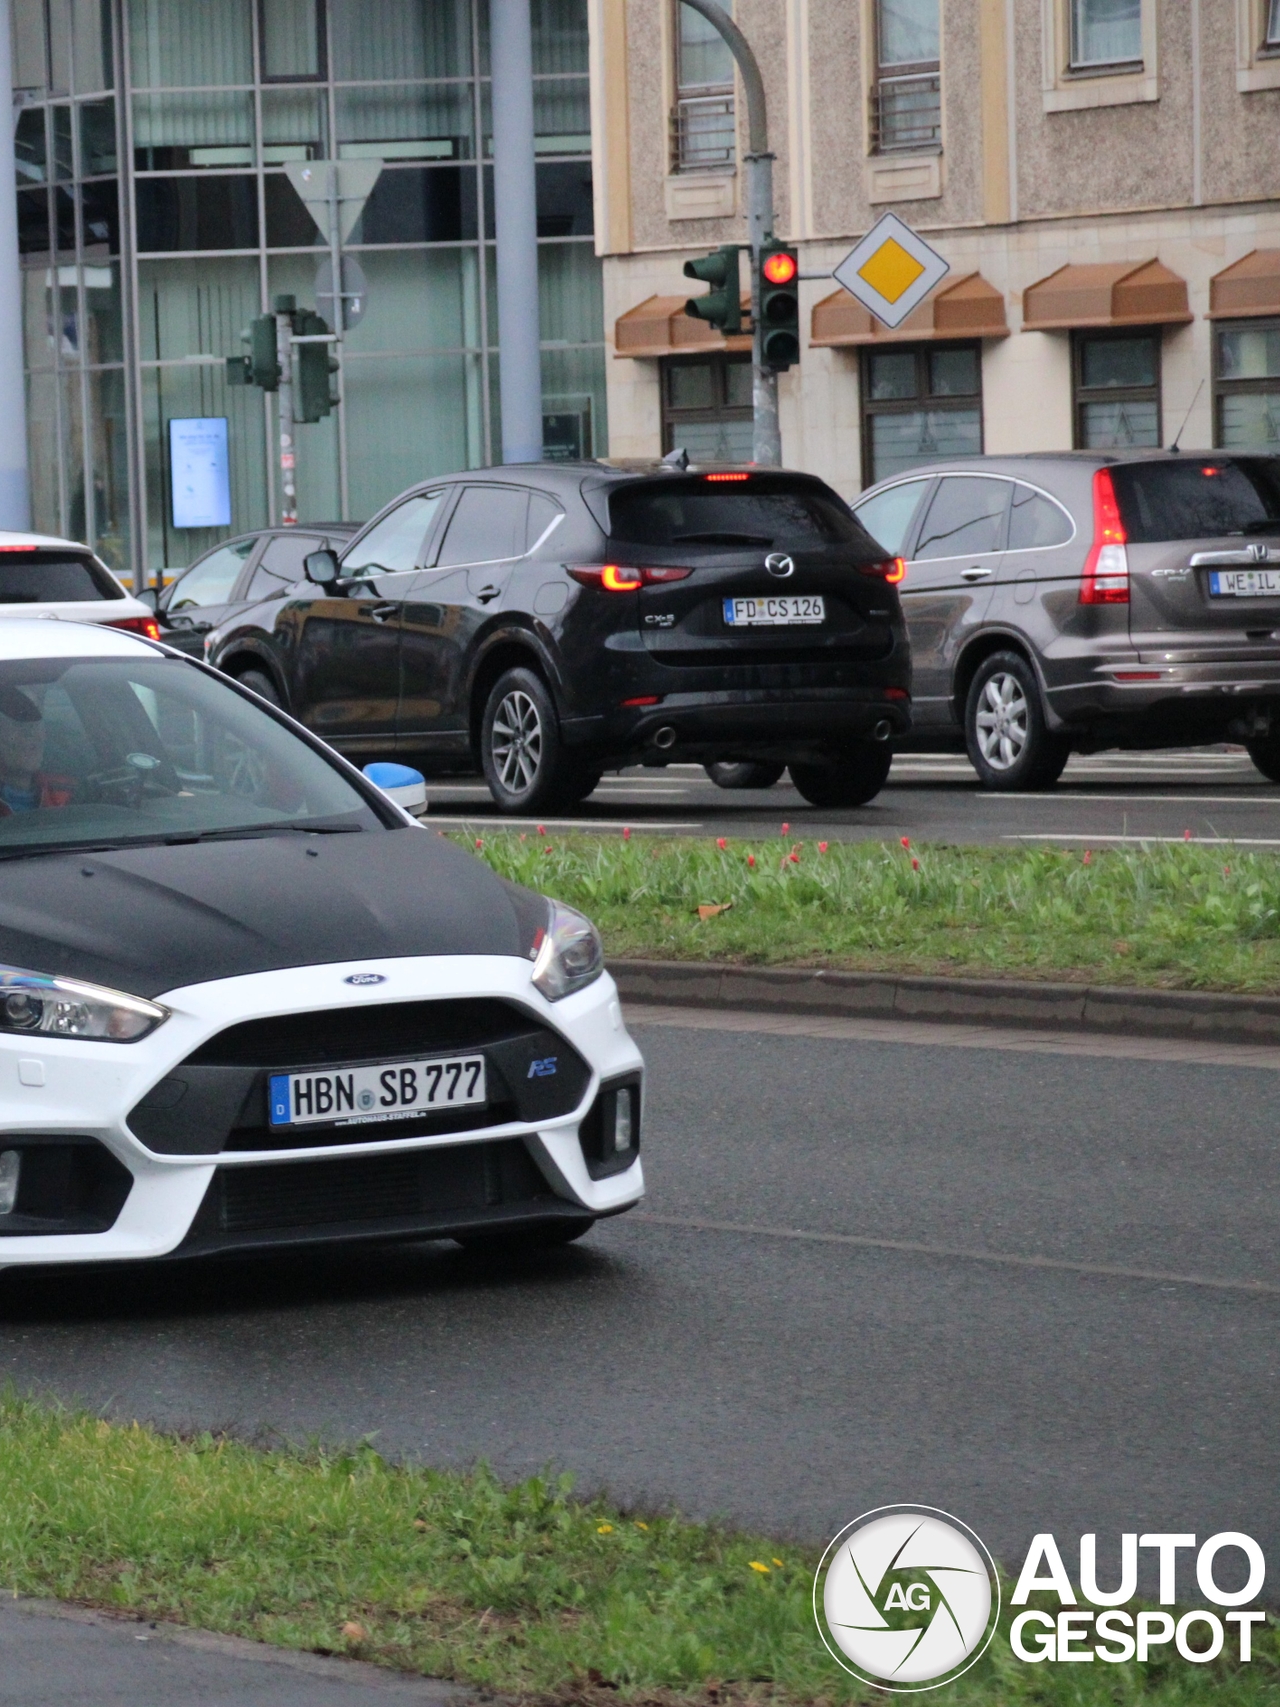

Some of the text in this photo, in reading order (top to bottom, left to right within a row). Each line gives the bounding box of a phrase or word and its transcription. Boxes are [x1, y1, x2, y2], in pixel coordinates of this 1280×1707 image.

[1226, 574, 1246, 591] WE
[735, 598, 822, 618] FD CS 126
[644, 614, 675, 624] CX-5
[352, 974, 380, 984] Ford
[527, 1056, 558, 1079] RS
[276, 1061, 481, 1116] D HBN SB 777
